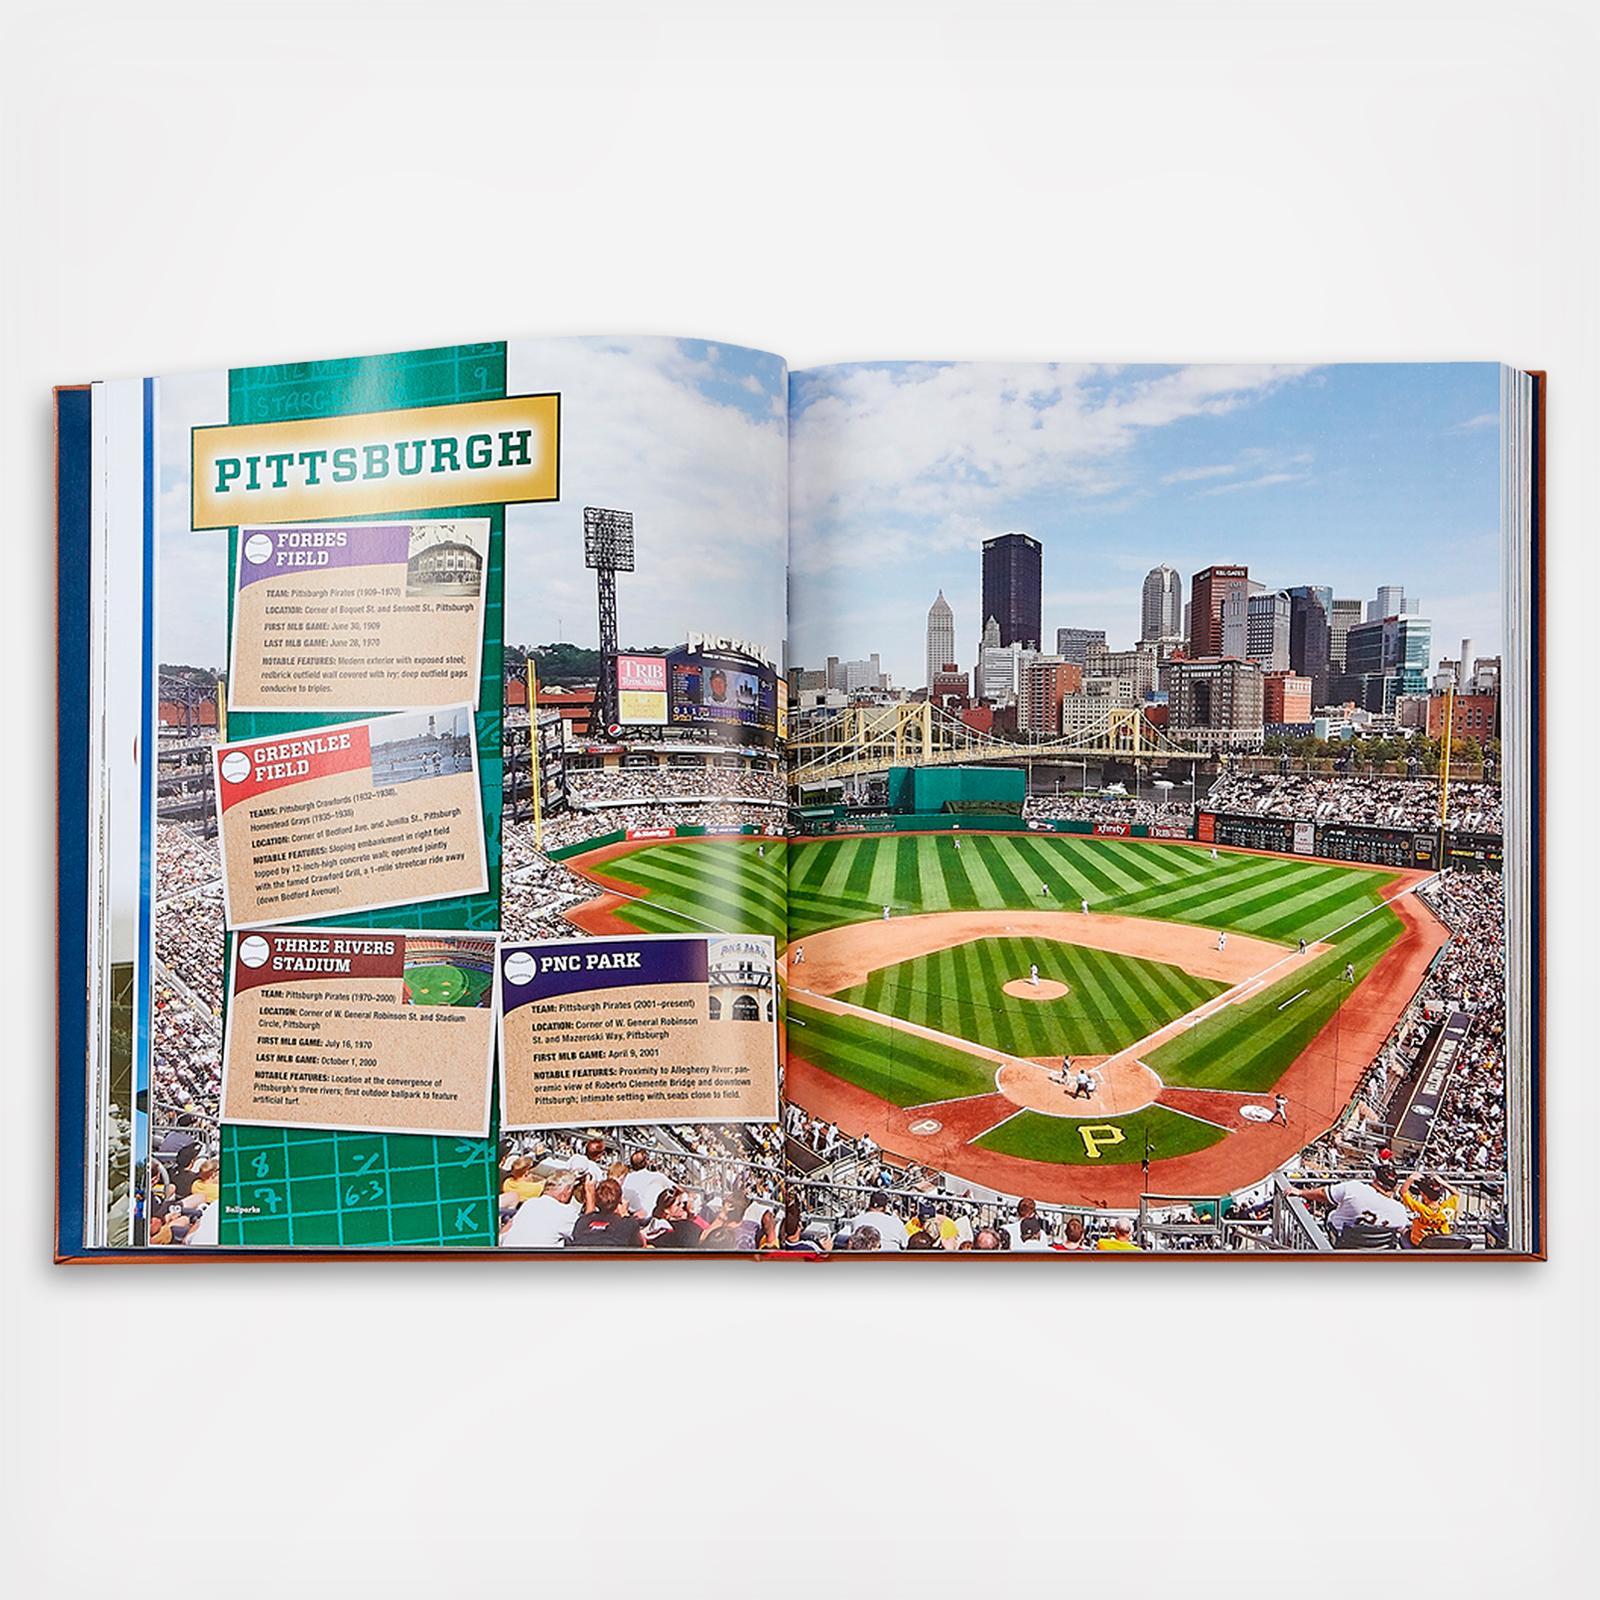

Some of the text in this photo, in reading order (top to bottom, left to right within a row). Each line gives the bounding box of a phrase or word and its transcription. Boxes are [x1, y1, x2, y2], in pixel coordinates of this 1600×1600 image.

[214, 430, 532, 494] PITTSBURGH
[276, 532, 348, 548] FORBES
[276, 551, 330, 566] FIELD
[687, 630, 728, 655] PNC
[730, 638, 770, 669] PARK
[621, 659, 664, 679] TRIB
[254, 733, 351, 764] GREENLEE
[255, 759, 310, 782] FIELD
[1097, 824, 1127, 835] xfinity
[252, 852, 286, 864] NOTABLE
[274, 938, 395, 956] THREE RIVERS
[272, 957, 352, 973] STADIUM
[540, 952, 642, 973] PNC PARK
[284, 990, 323, 1002] Pittsburgh
[324, 992, 350, 1000] Pirates
[298, 1008, 323, 1016] Corner
[324, 1009, 332, 1017] of
[343, 1010, 372, 1018] General
[372, 1011, 407, 1020] Robinson
[419, 1013, 433, 1021] and
[434, 1013, 466, 1022] Stadium
[531, 1004, 557, 1013] TEAM:
[558, 1003, 601, 1015] Pittsburgh
[602, 1001, 631, 1010] Pirates
[282, 1020, 320, 1032] Pittsburgh
[531, 1021, 574, 1030] LOCATION:
[575, 1021, 603, 1029] Corner
[604, 1019, 613, 1028] of
[626, 1019, 658, 1027] General
[659, 1017, 698, 1026] Robinson
[256, 1036, 278, 1045] FIRST
[280, 1037, 296, 1045] MLB
[324, 1039, 340, 1049] July
[544, 1035, 560, 1043] and
[625, 1030, 669, 1043] Pittsburgh
[255, 1053, 274, 1062] LAST
[275, 1054, 293, 1062] MLB
[320, 1056, 349, 1065] October
[532, 1052, 556, 1061] FIRST
[558, 1052, 576, 1060] MLB
[578, 1050, 606, 1059] GAME:
[607, 1050, 628, 1061] April
[639, 1048, 659, 1057] 2001
[254, 1070, 287, 1080] NOTABLE
[330, 1075, 362, 1083] Location
[363, 1076, 371, 1084] at
[386, 1078, 432, 1089] convergence
[433, 1079, 442, 1087] of
[533, 1070, 570, 1079] NOTABLE
[572, 1068, 617, 1077] FEATURES:
[618, 1067, 658, 1079] Proximity
[659, 1067, 669, 1075] to
[670, 1066, 709, 1078] Allegheny
[533, 1083, 562, 1092] oramic
[563, 1082, 582, 1090] view
[594, 1081, 627, 1089] Roberto
[628, 1079, 667, 1088] Clemente
[669, 1078, 695, 1090] Bridge
[697, 1078, 712, 1086] and
[713, 1078, 751, 1086] downtown
[252, 1096, 283, 1104] artificial
[298, 1086, 318, 1094] three
[360, 1088, 389, 1097] outdoor
[390, 1090, 420, 1100] ballpark
[422, 1091, 430, 1099] to
[431, 1091, 458, 1100] feature
[580, 1094, 614, 1102] intimate
[615, 1093, 645, 1104] setting
[666, 1092, 688, 1100] seats
[690, 1092, 711, 1100] close
[712, 1091, 721, 1099] to
[1077, 1122, 1126, 1159] P
[252, 1151, 270, 1178] 8
[254, 1187, 283, 1214] 7
[455, 1203, 479, 1232] K
